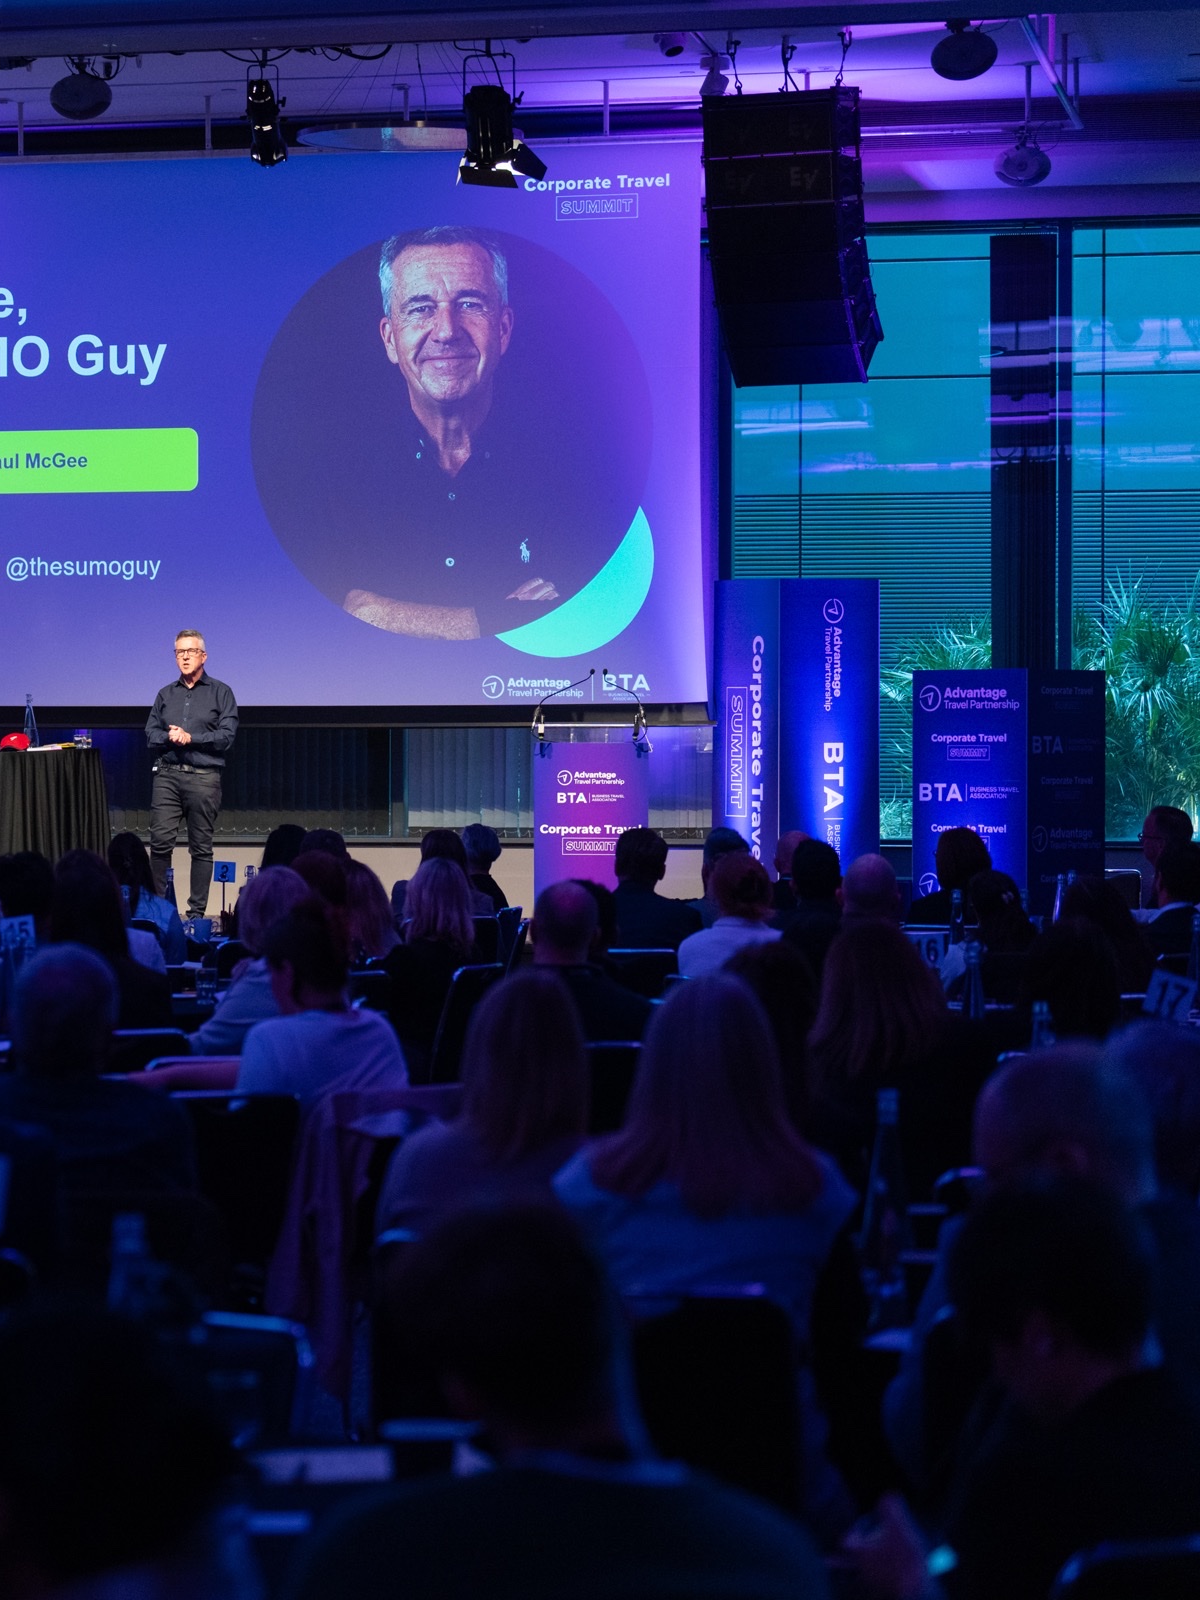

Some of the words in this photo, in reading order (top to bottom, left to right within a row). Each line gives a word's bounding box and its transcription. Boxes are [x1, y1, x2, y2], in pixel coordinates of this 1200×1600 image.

[524, 176, 611, 193] Corporate
[617, 173, 670, 188] Travel
[560, 199, 633, 215] SUMMIT
[67, 334, 167, 386] Guy
[25, 452, 88, 470] McGee
[6, 555, 161, 582] @thesumoguy
[824, 626, 832, 656] Travel
[832, 626, 842, 697] Advantage
[508, 677, 571, 690] Advantage
[602, 673, 651, 691] BTA
[823, 657, 832, 711] Partnership
[507, 688, 533, 697] Travel
[534, 688, 584, 699] Partnership
[944, 687, 1007, 700] Advantage
[750, 635, 764, 776] Corporate
[944, 700, 968, 709] Travel
[970, 699, 1020, 711] Partnership
[931, 733, 976, 744] Corporate
[978, 733, 1007, 742] Travel
[731, 695, 743, 808] SUMMIT
[950, 748, 987, 757] SUMMIT
[574, 771, 616, 780] Advantage
[823, 742, 844, 813] BTA
[557, 792, 587, 803] BTA
[919, 783, 963, 801] BTA
[540, 824, 601, 836] Corporate
[751, 783, 764, 866] Trave
[978, 824, 1006, 833] Travel
[566, 841, 616, 851] SUMMIT
